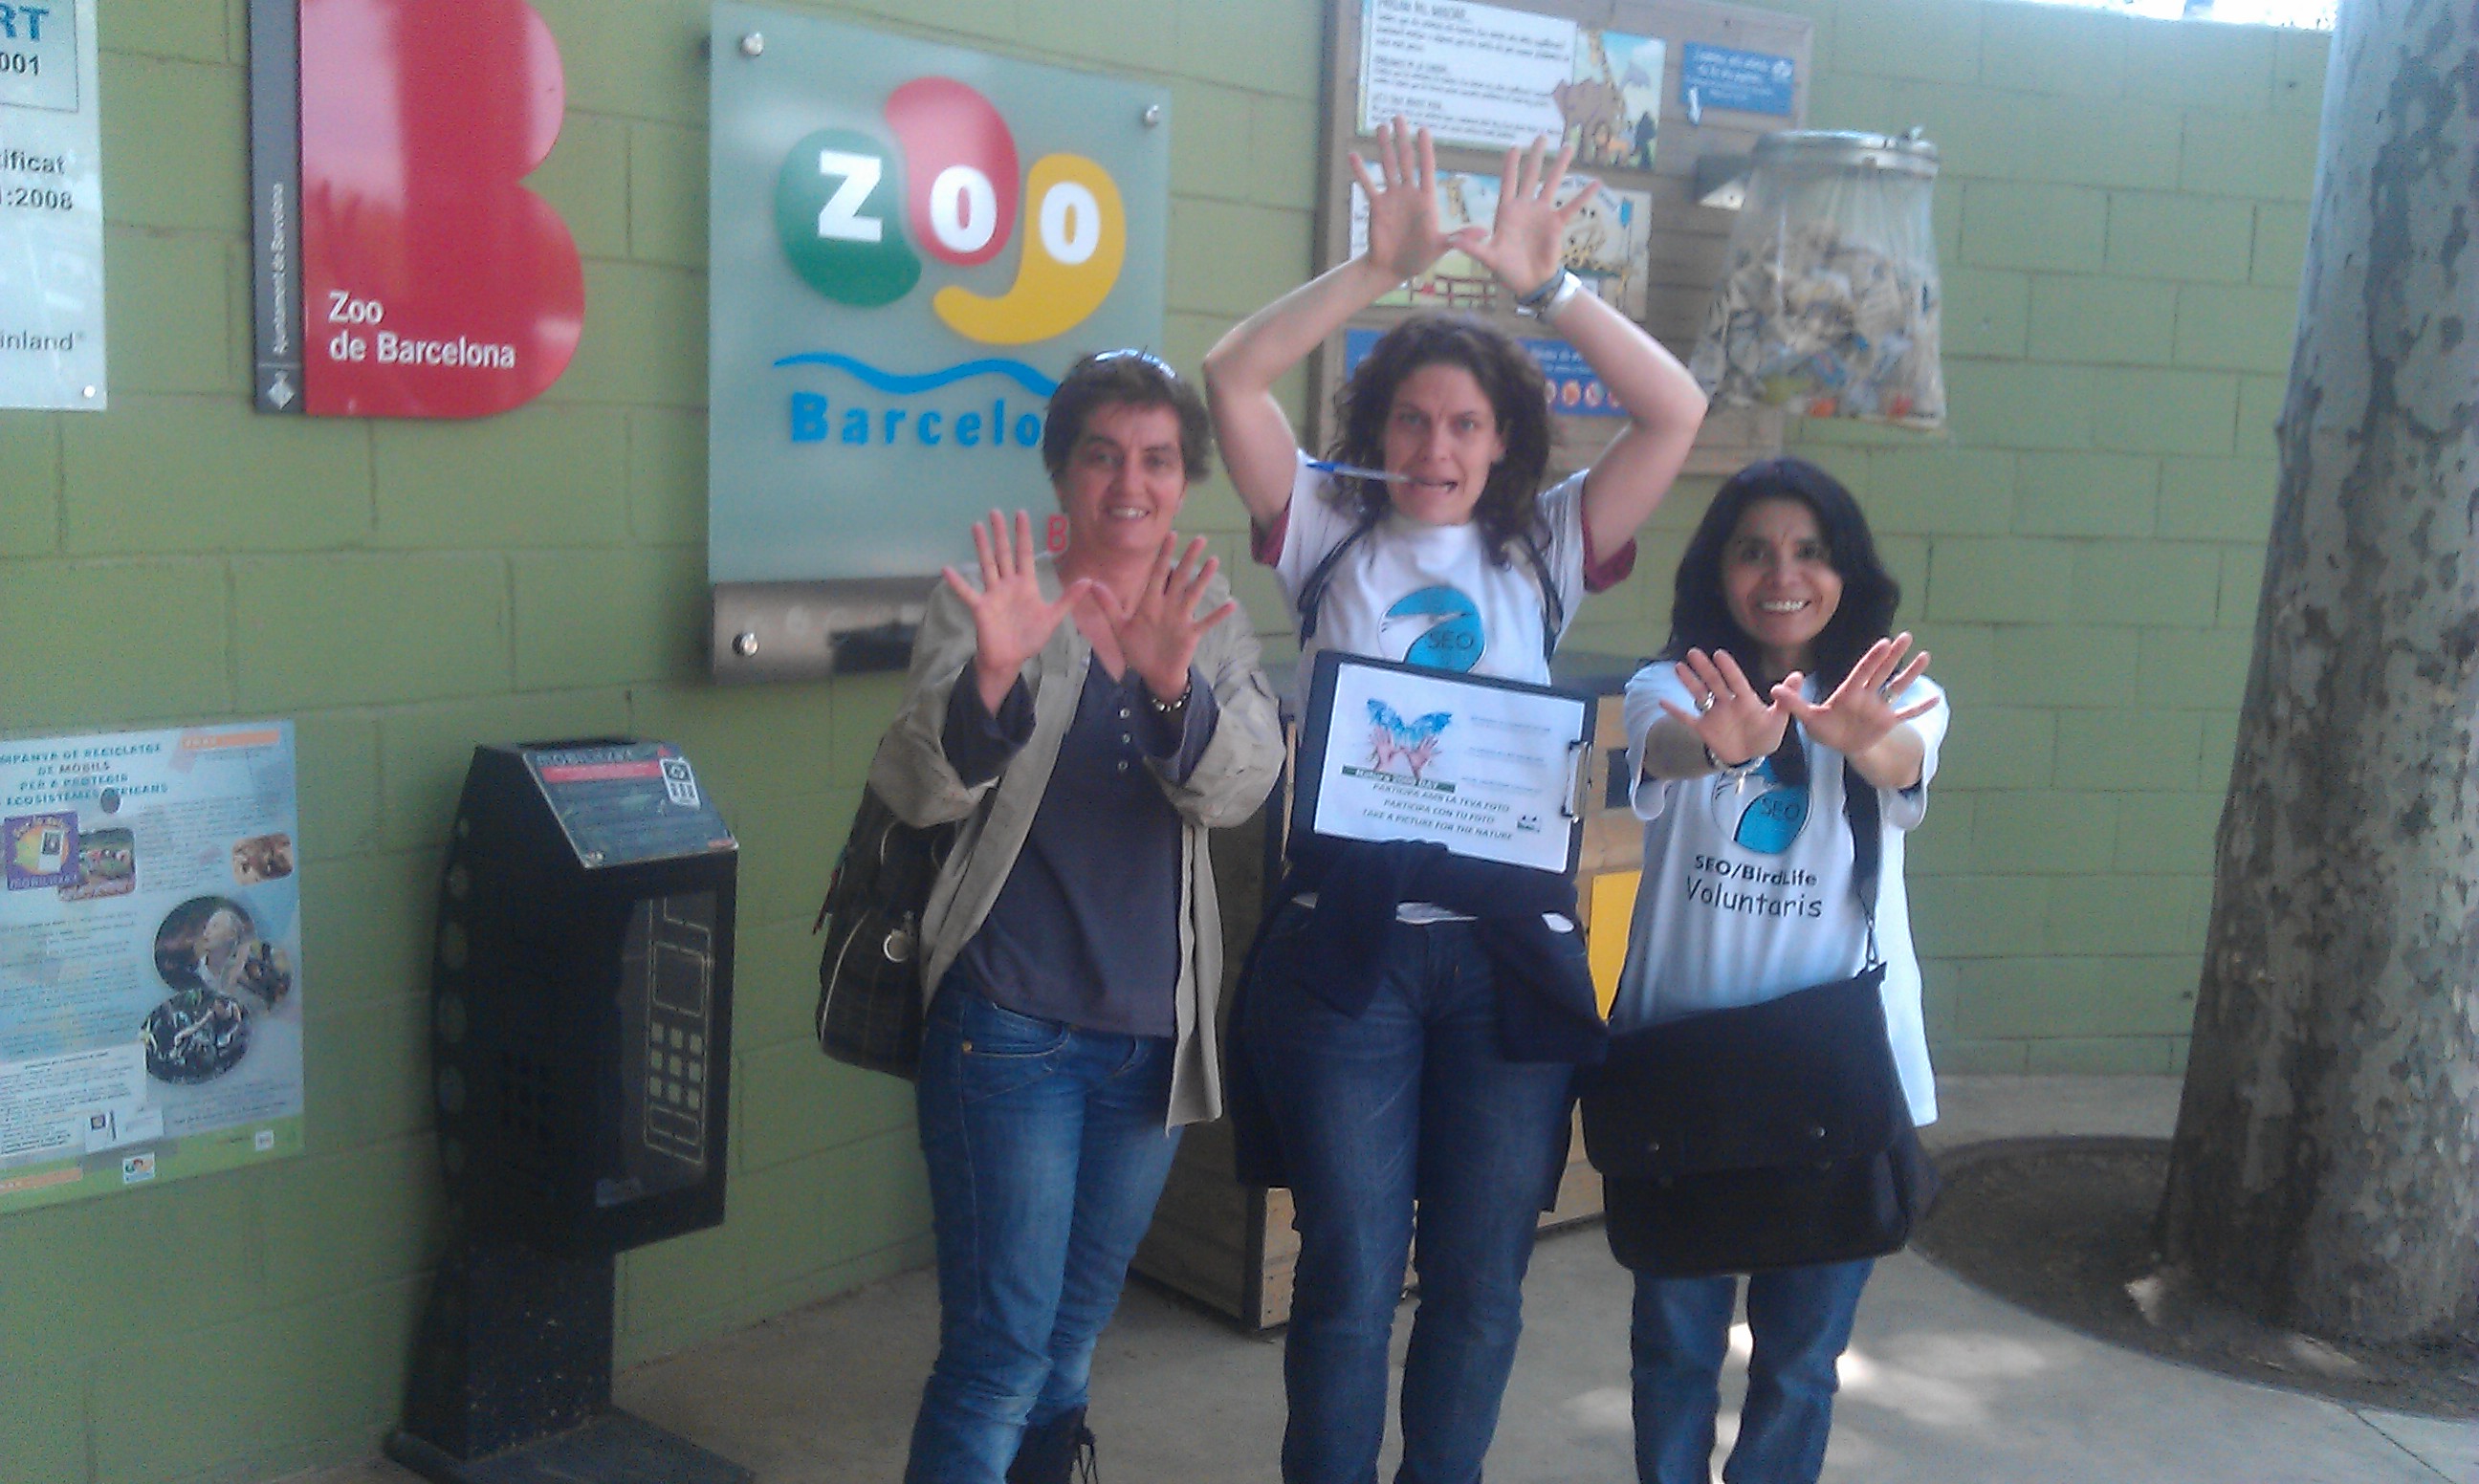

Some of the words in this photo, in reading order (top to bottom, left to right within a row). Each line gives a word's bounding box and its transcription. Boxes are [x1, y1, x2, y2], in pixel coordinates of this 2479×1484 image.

[0, 53, 38, 76] 001
[0, 148, 66, 174] ificat
[328, 290, 384, 325] Zoo
[328, 329, 367, 361] de
[377, 331, 516, 369] Barcelona
[1428, 631, 1474, 650] SEO
[1761, 797, 1800, 821] SEO
[1695, 854, 1818, 886] SEO/BirdLife
[1687, 875, 1823, 918] Voluntaris
